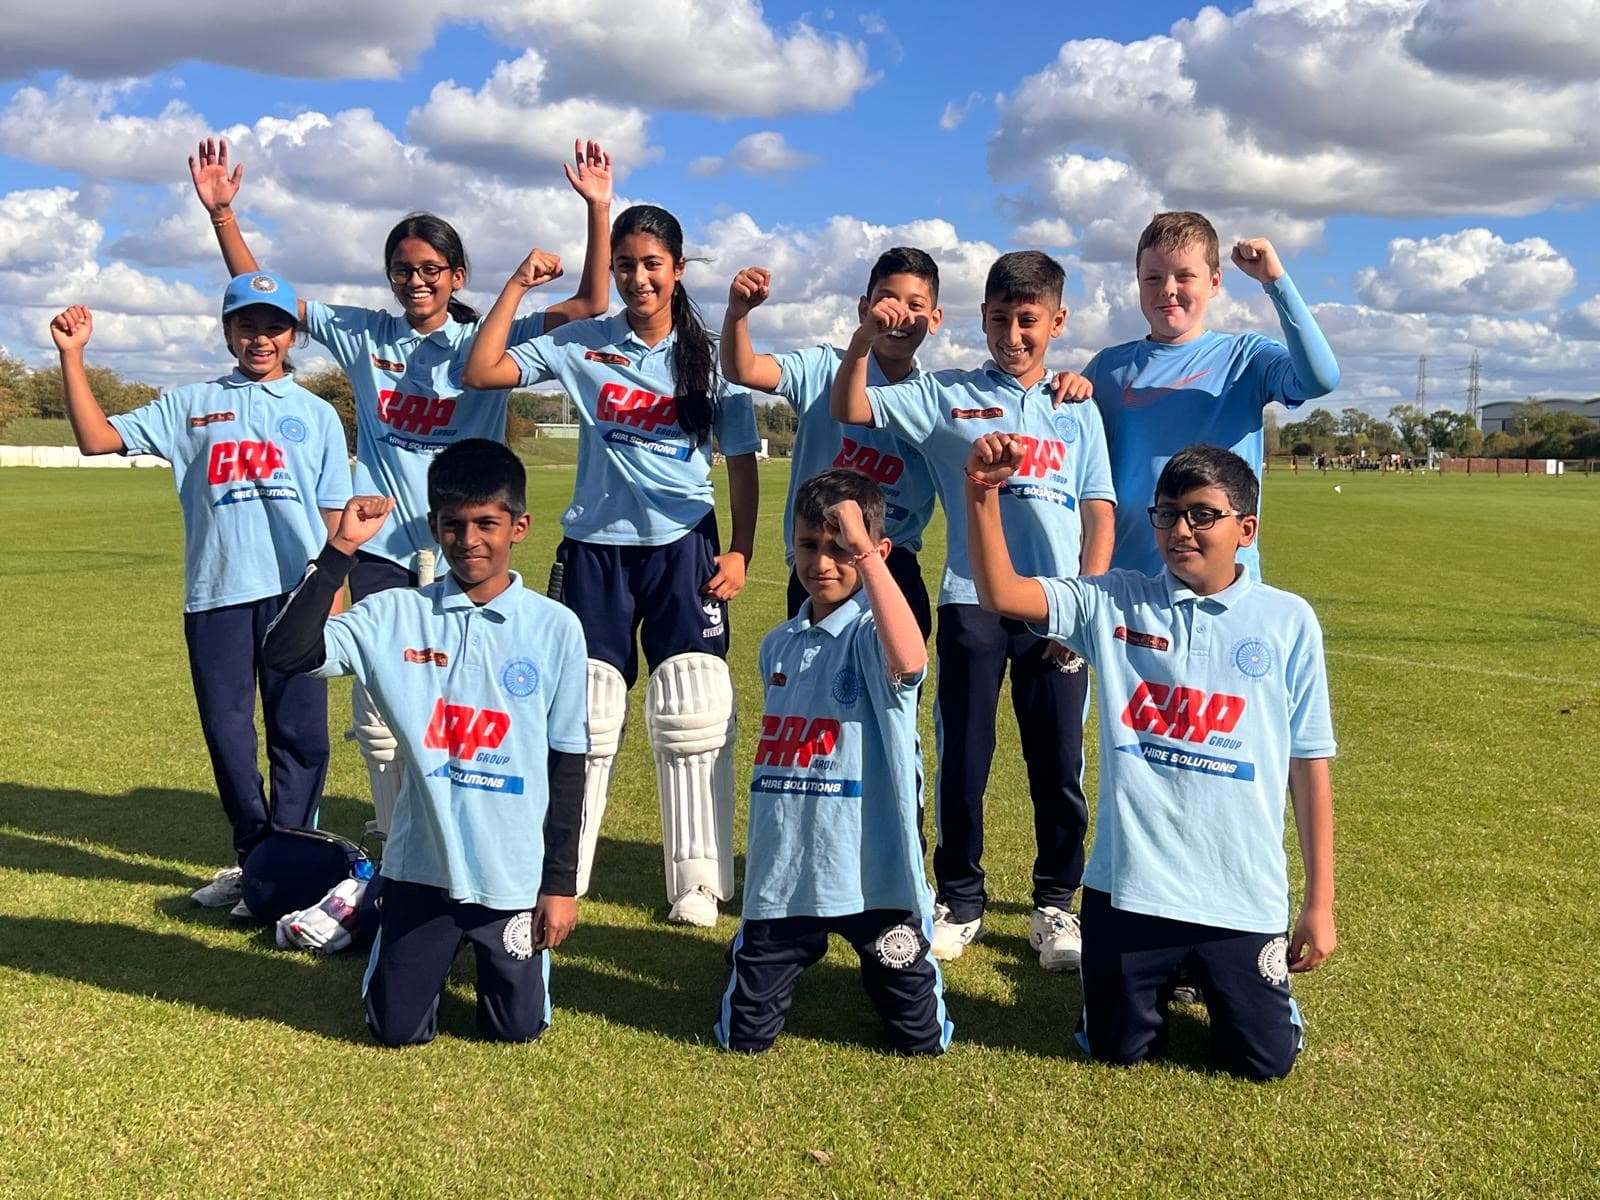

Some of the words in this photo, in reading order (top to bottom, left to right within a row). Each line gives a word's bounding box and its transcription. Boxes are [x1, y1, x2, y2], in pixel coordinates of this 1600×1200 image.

[377, 389, 457, 436] GAP
[597, 383, 678, 432] GAP
[612, 431, 629, 442] HIRE
[630, 436, 677, 455] SOLUTIONS
[1017, 436, 1067, 479] AP
[208, 440, 286, 486] GAP
[1121, 681, 1247, 743] GAP
[476, 753, 510, 765] GROUP
[1143, 746, 1169, 761] HIRE
[1170, 753, 1238, 773] SOLUTIONS
[1209, 736, 1242, 750] GROUP
[761, 779, 782, 789] HIRE
[783, 780, 841, 793] SOLUTIONS
